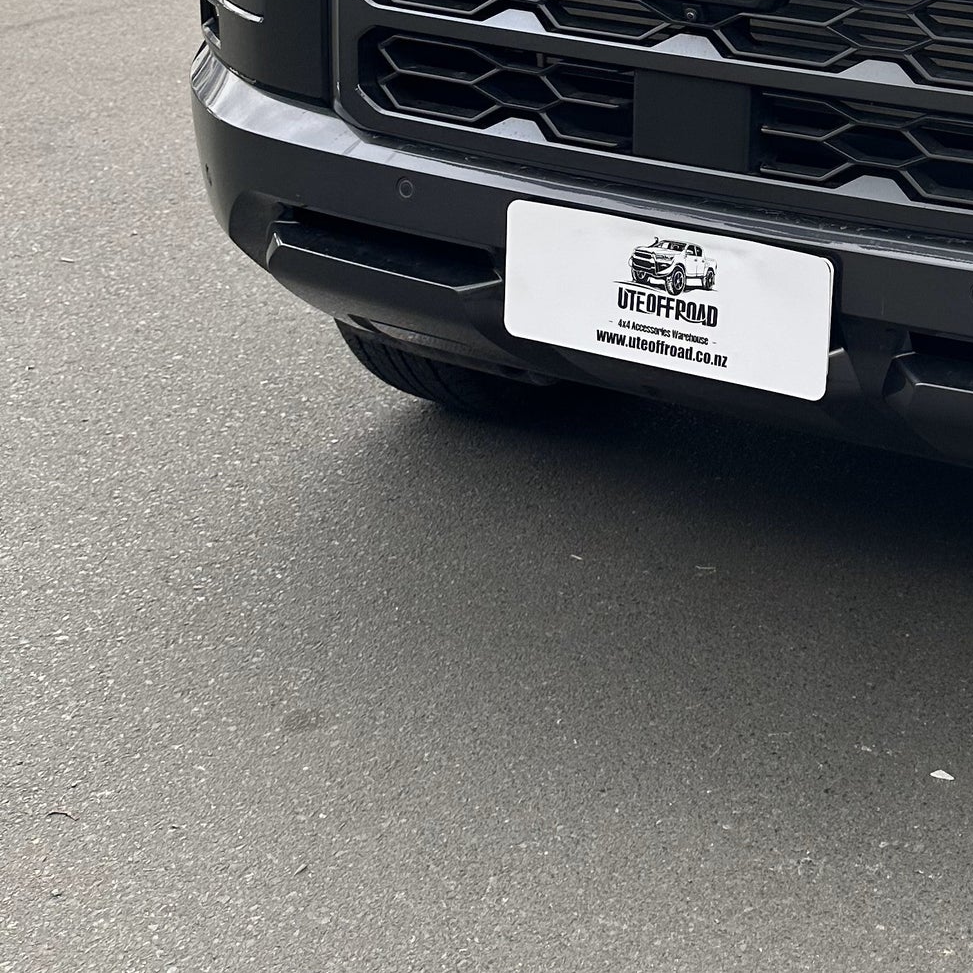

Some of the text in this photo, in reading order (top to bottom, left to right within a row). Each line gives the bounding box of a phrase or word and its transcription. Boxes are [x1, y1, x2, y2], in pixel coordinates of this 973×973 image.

[617, 286, 719, 328] UTEOFFROAD
[596, 329, 728, 368] www.uteoffroad.co.nz
[617, 318, 709, 346] 4x4 Accessories Warehouse
